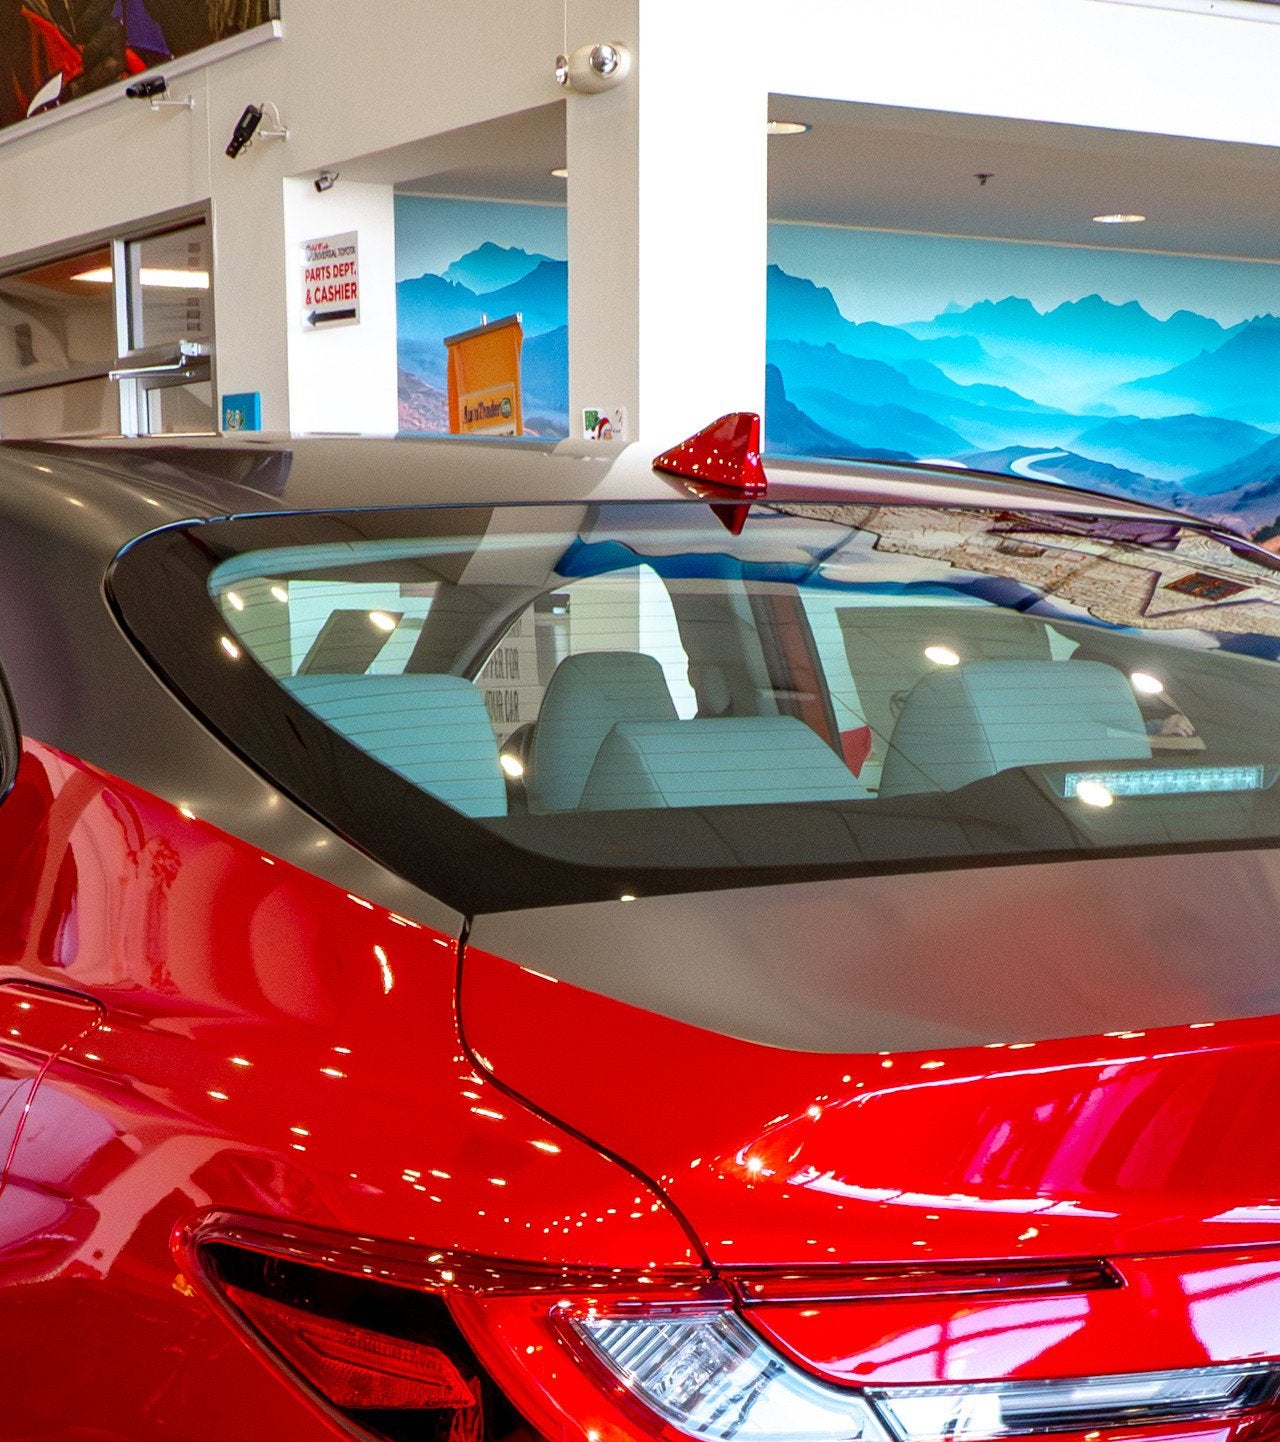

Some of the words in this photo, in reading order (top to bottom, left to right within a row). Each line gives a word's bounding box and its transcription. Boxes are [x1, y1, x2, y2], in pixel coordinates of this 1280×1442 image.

[305, 265, 331, 283] PARTS
[333, 261, 357, 278] DEPT.
[305, 289, 312, 304] &
[314, 282, 357, 305] CASHIER
